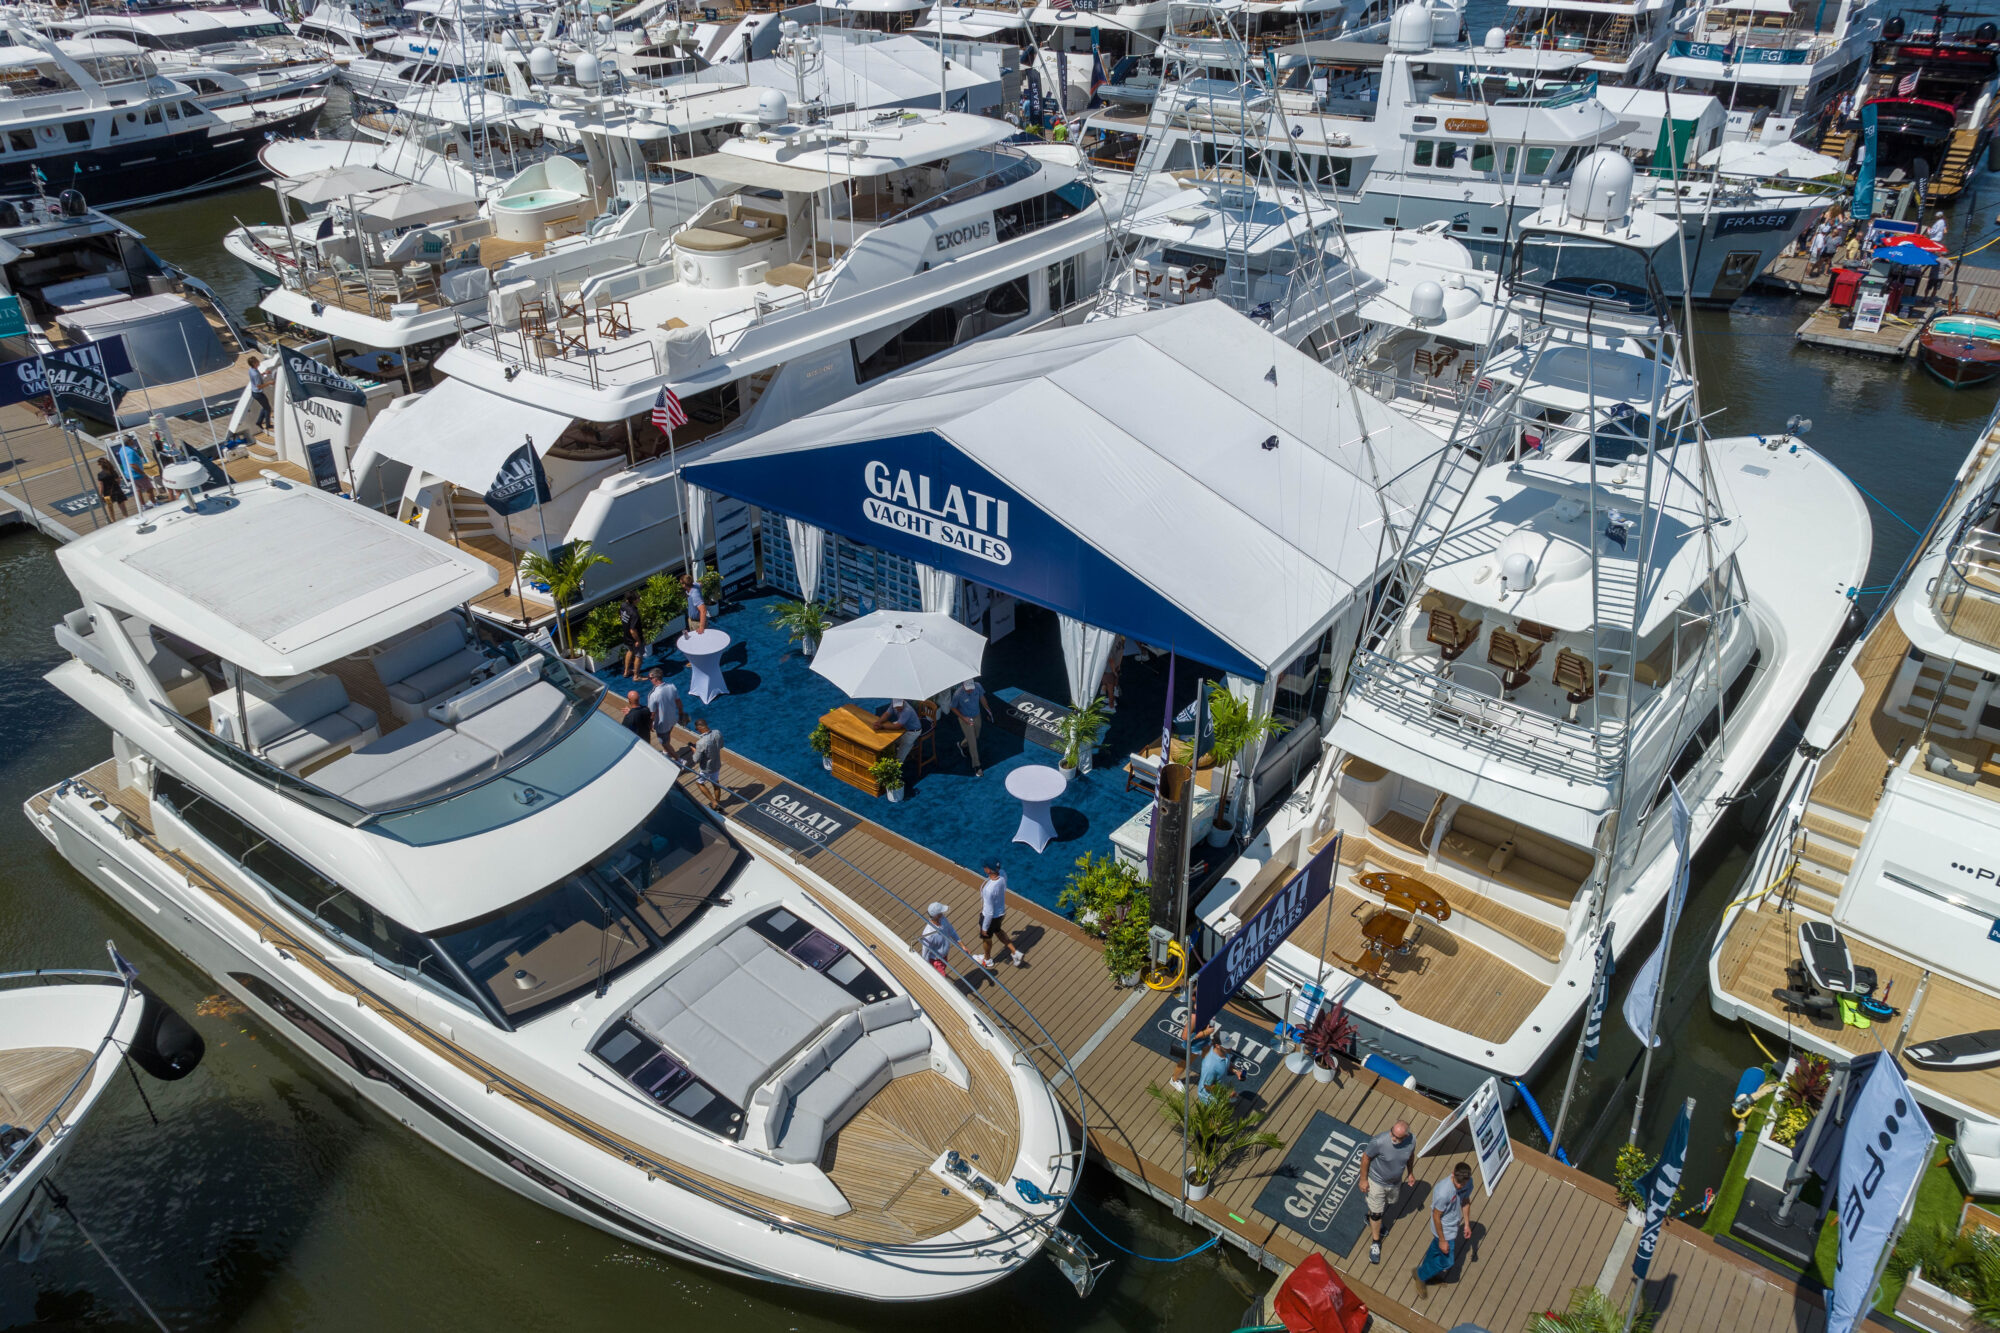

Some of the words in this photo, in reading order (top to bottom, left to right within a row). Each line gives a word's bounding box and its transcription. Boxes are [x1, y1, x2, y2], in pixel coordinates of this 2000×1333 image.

[1690, 44, 1709, 56] FGI
[1761, 50, 1782, 61] FGI
[935, 221, 990, 252] EXODUS
[1723, 215, 1787, 229] FRASER
[864, 460, 1009, 538] GALATI
[869, 501, 933, 536] YACHT
[941, 525, 1006, 561] SALES
[765, 806, 795, 824] YACHT
[792, 822, 821, 840] SALES
[770, 794, 842, 835] GALATI
[1226, 869, 1309, 972] GALATI
[1229, 941, 1267, 988] YACHT
[1268, 902, 1303, 947] SALES
[1284, 1130, 1356, 1218] GALATI
[1314, 1183, 1348, 1223] YACHT
